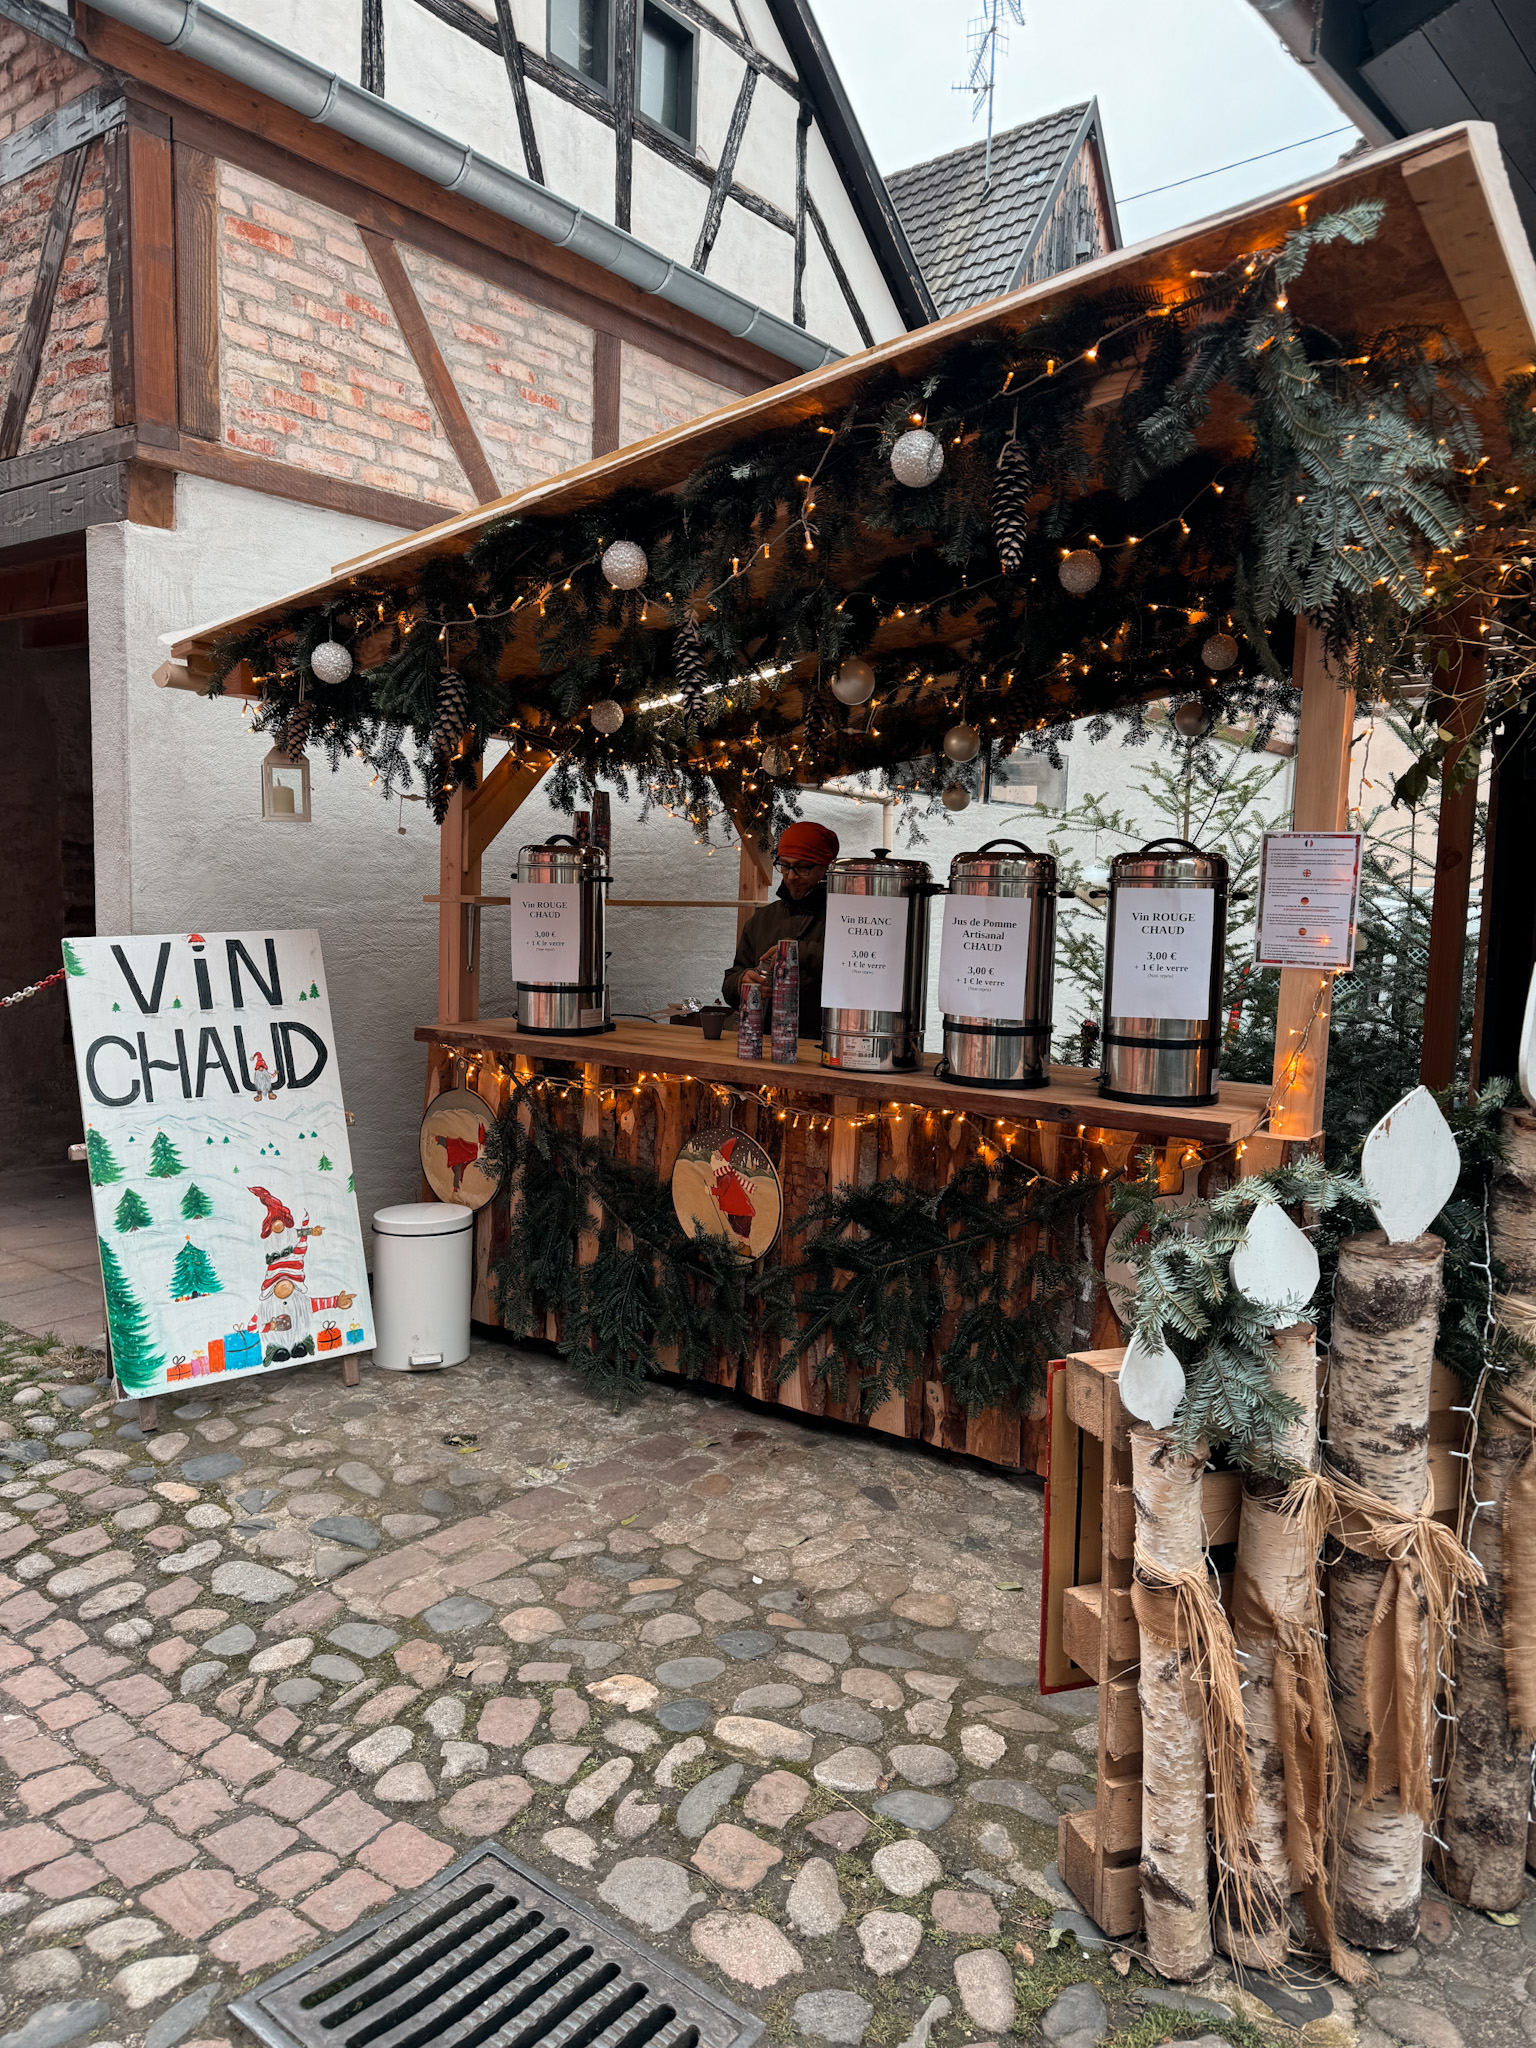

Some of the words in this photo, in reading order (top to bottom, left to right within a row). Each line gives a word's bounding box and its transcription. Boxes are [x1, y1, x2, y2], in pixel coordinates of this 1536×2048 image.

[858, 916, 892, 925] BLANC
[1132, 912, 1149, 921] Vin
[1153, 912, 1196, 922] ROUGE
[952, 917, 967, 925] Jus
[970, 918, 980, 926] de
[983, 919, 1017, 928] Pomme
[847, 927, 883, 936] CHAUD
[1141, 926, 1185, 934] CHAUD
[962, 930, 1004, 940] Artisanal
[963, 942, 1002, 952] CHAUD
[851, 950, 869, 959] 3,00
[871, 951, 877, 959] €
[1146, 952, 1168, 961] 3,00
[1170, 952, 1177, 960] €
[967, 966, 986, 975] 3,00
[989, 967, 995, 975] €
[86, 1022, 328, 1107] CHAUD
